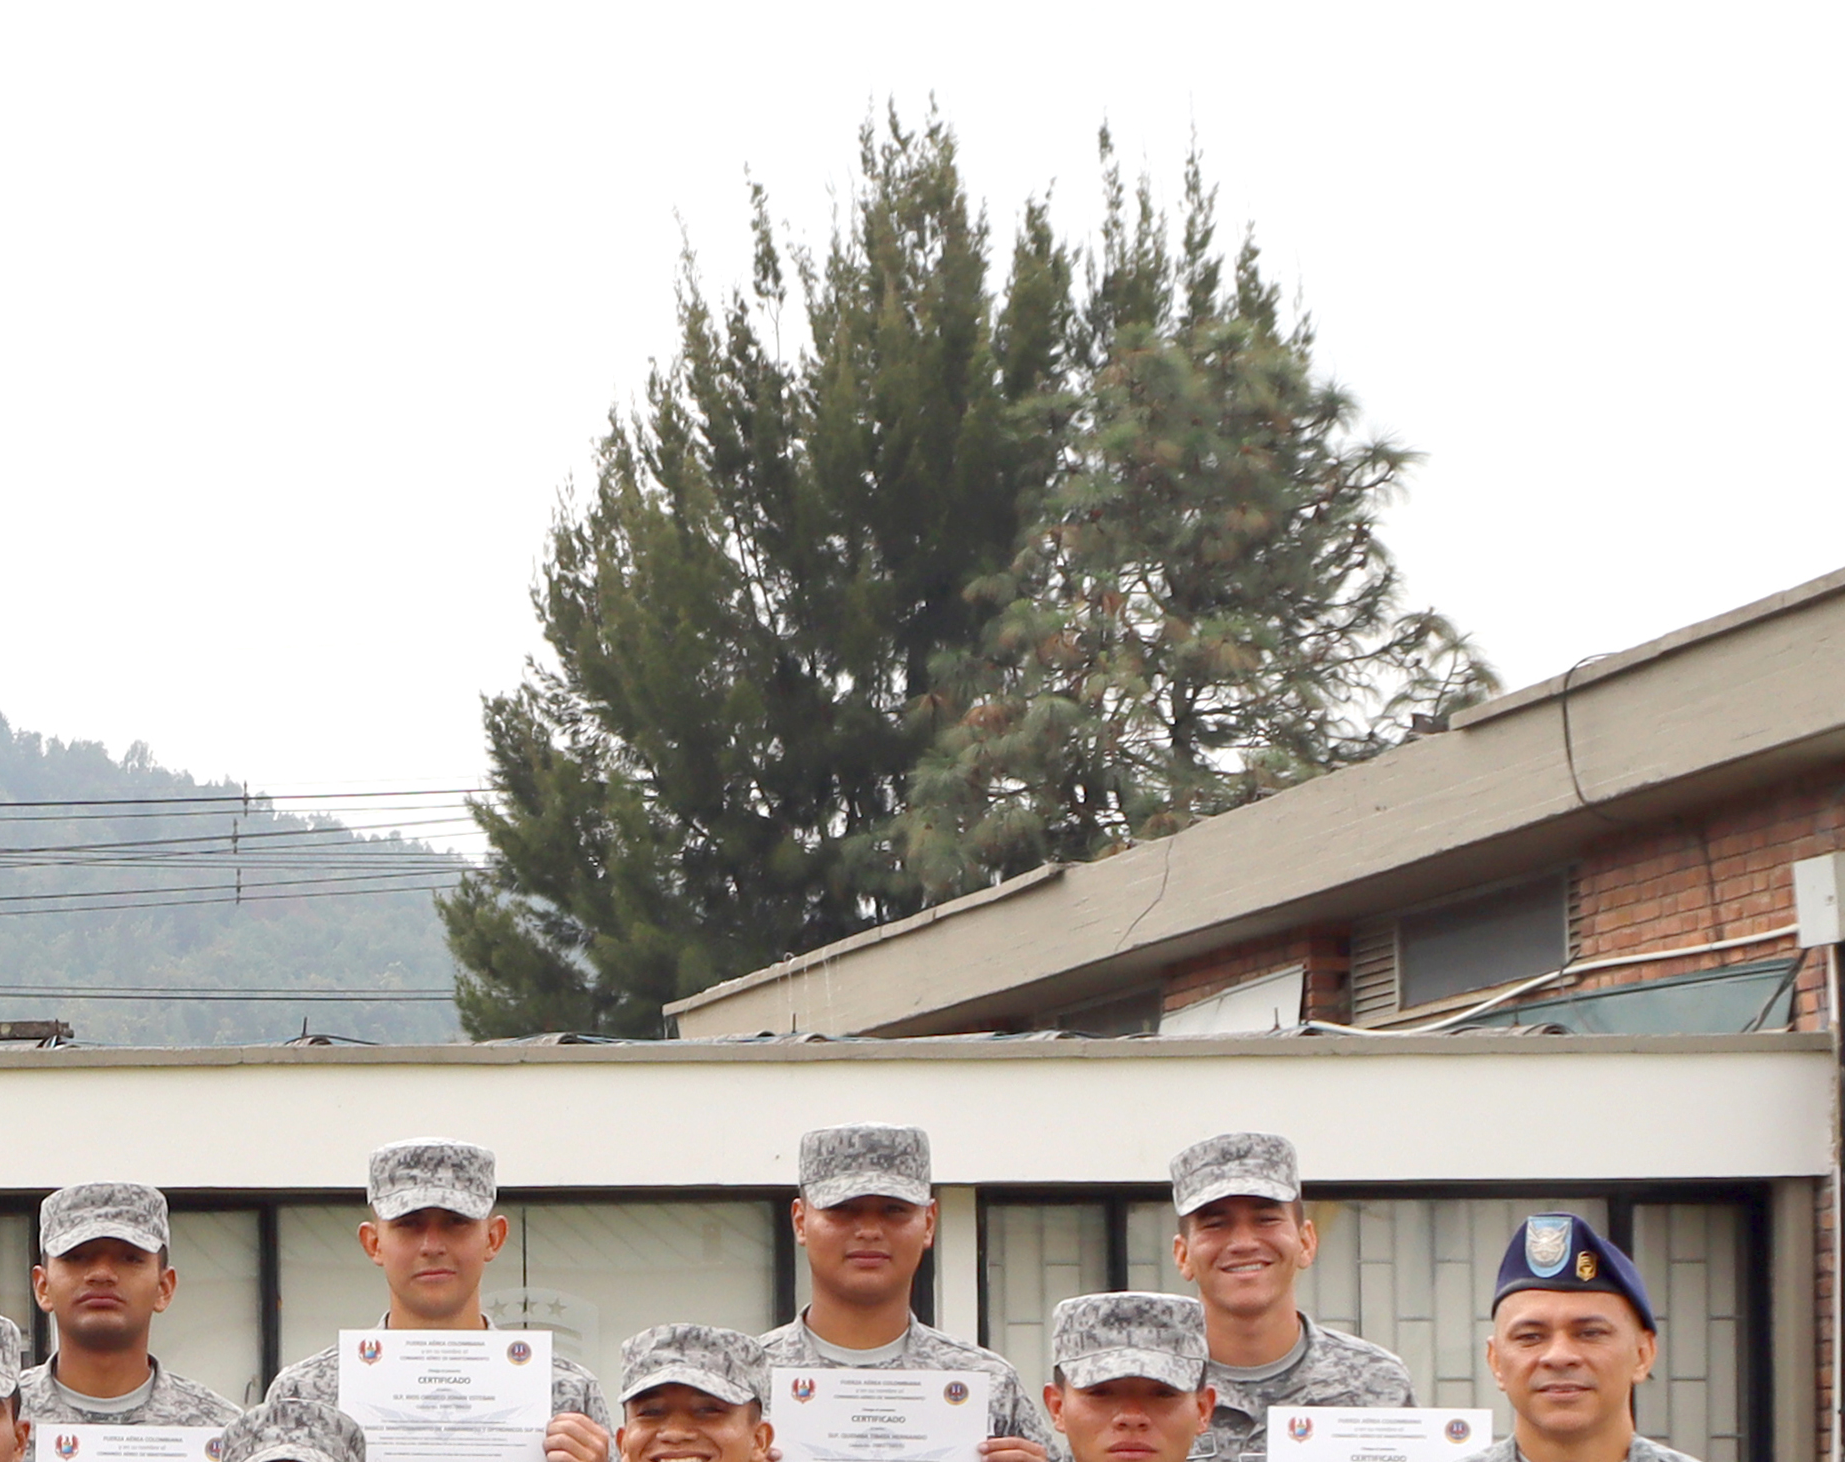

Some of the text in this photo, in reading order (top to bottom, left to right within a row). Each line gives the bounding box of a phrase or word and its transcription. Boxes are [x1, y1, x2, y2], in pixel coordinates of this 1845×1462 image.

[418, 1377, 471, 1385] CERTIFICADO
[851, 1415, 906, 1424] CERTIFICADO
[1350, 1454, 1407, 1462] CERTIFICADO
